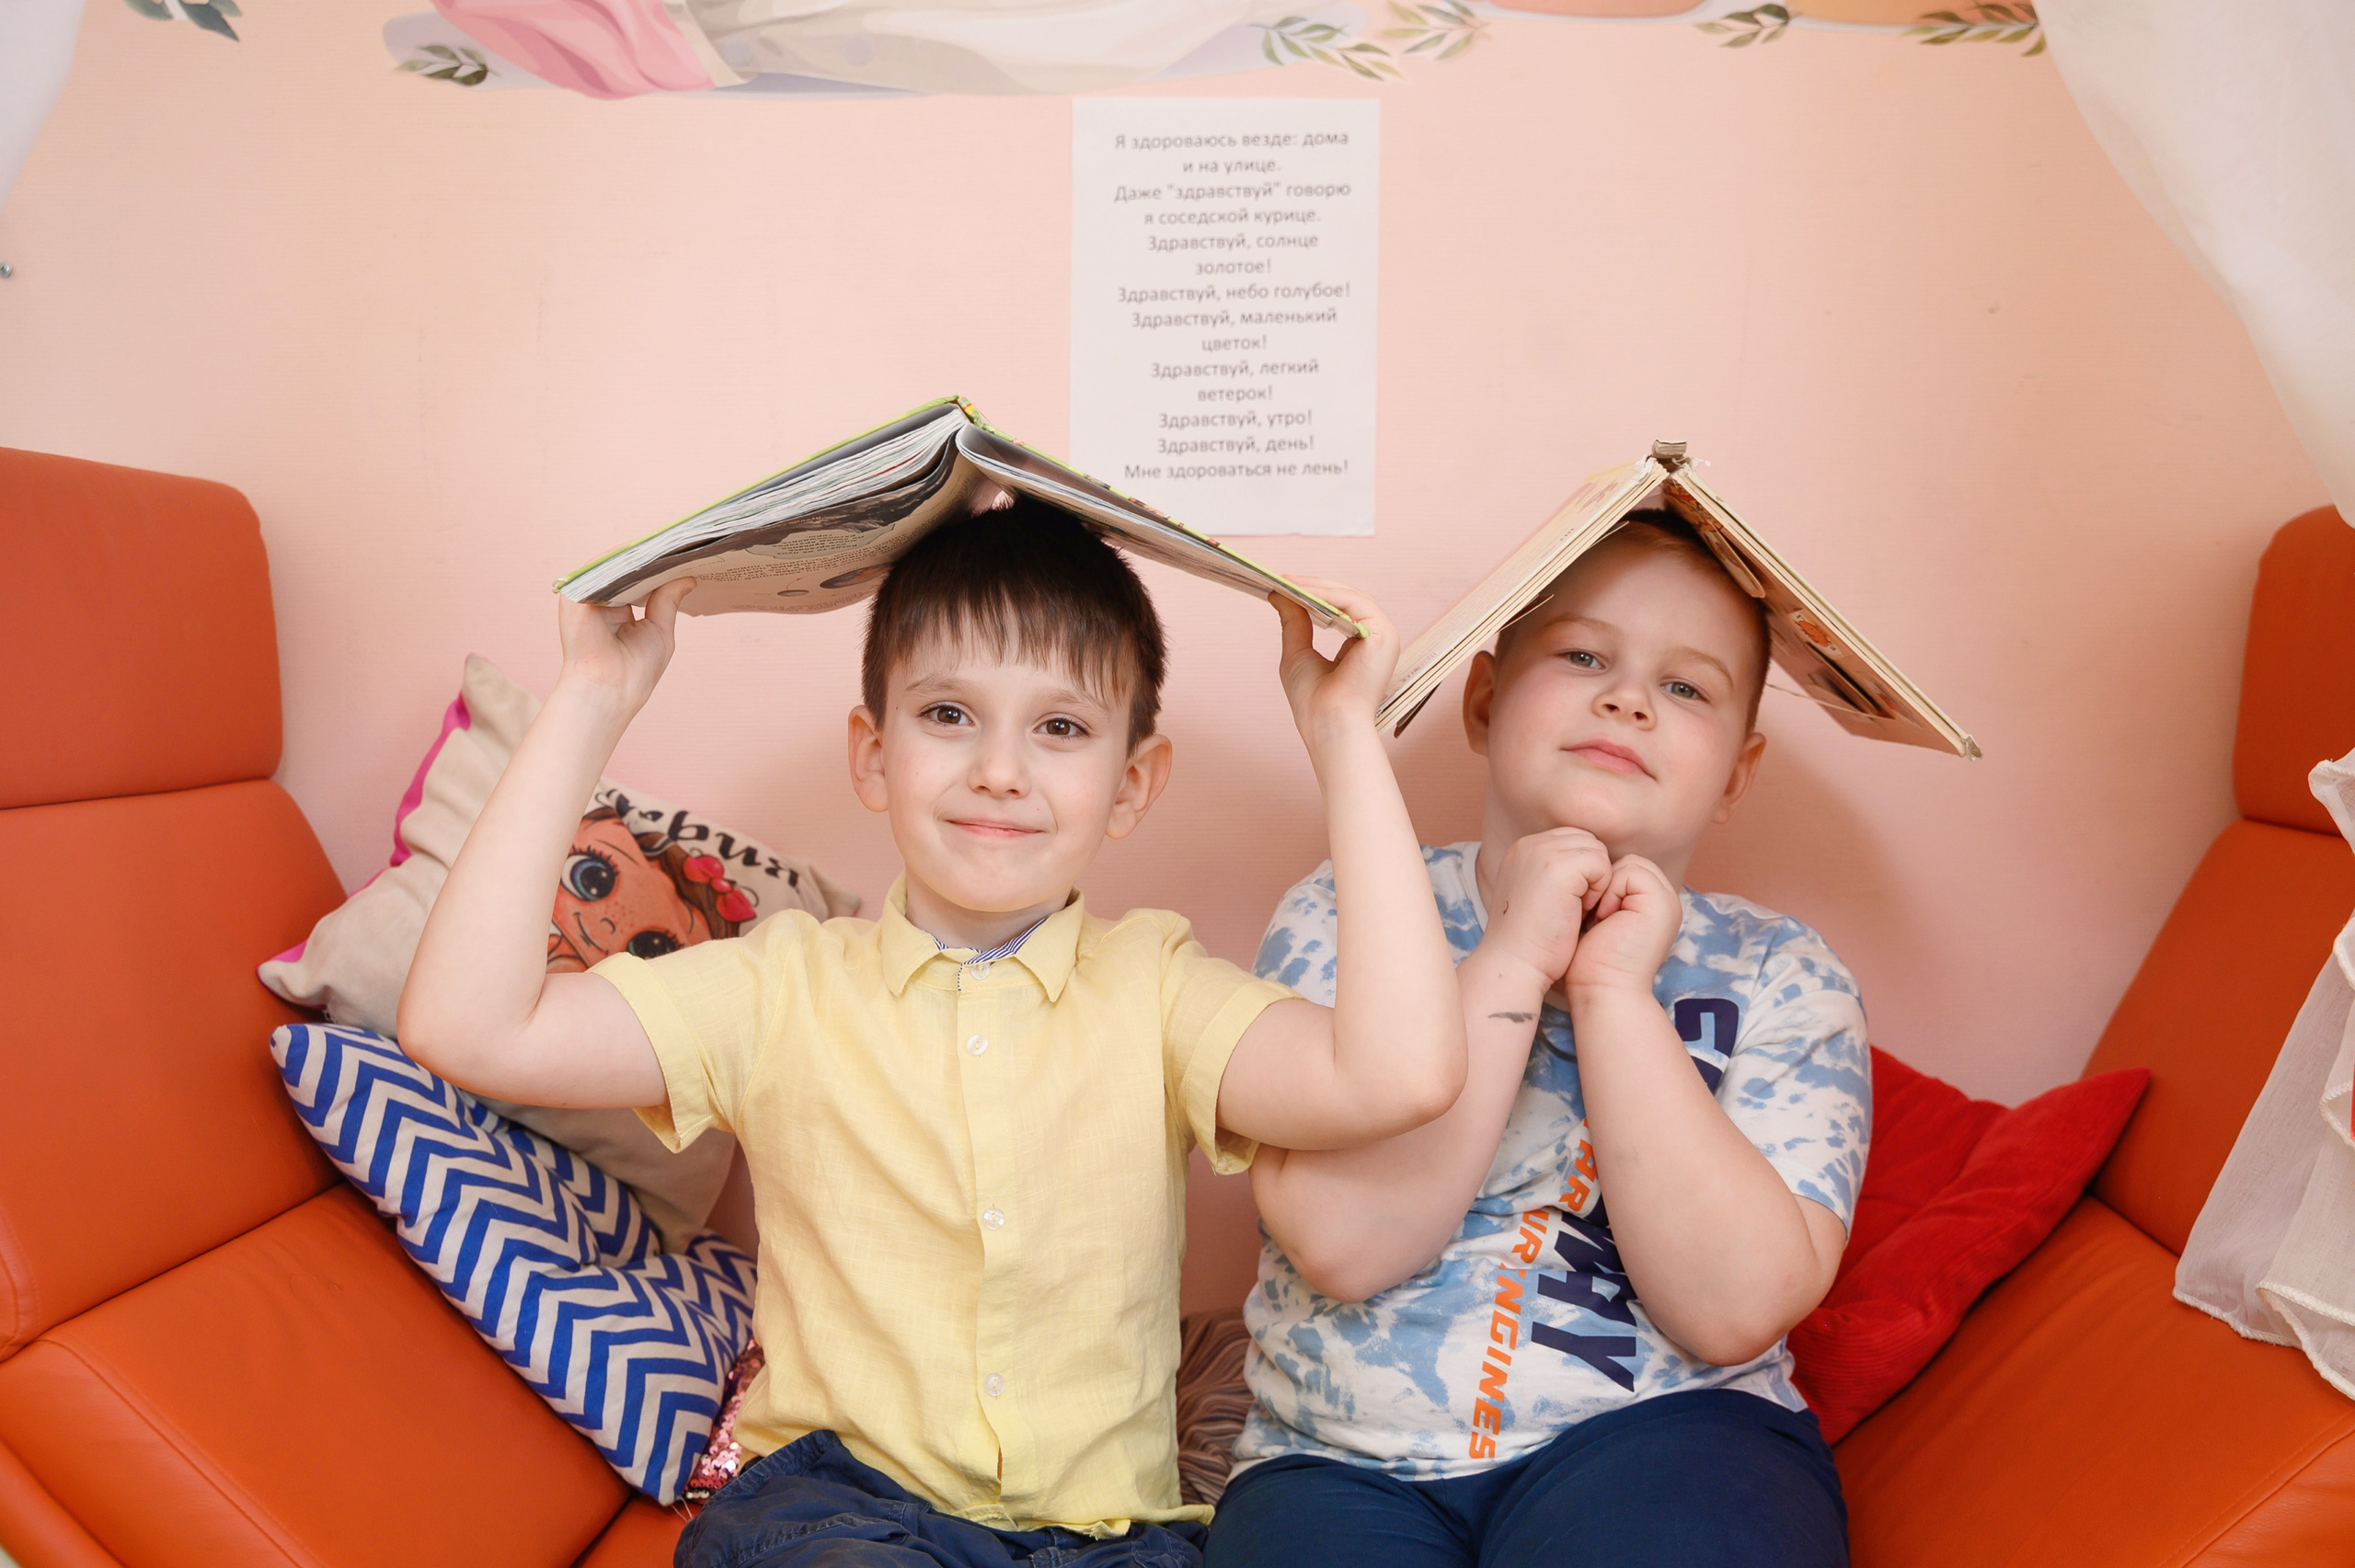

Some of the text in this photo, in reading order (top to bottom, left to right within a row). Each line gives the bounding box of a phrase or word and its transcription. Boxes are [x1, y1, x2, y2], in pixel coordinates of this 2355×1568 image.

[1115, 132, 1349, 151] Я здороваюсь везде: дома
[1183, 160, 1281, 176] и на улице.
[1114, 181, 1351, 203] Даже "здравствуй" говорю
[1144, 208, 1321, 226] я соседской курице.
[1148, 233, 1319, 253] Здравствуй, солнце
[1196, 258, 1271, 275] золотое!
[1118, 281, 1350, 304] Здравствуй, небо голубое!
[1132, 307, 1338, 330] Здравствуй, маленький
[1202, 335, 1267, 353] цветок!
[1152, 359, 1319, 380] Здравствуй, легкий
[1198, 384, 1272, 404] ветерок!
[1159, 409, 1312, 430] Здравствуй, утро!
[1158, 435, 1314, 456] Здравствуй, день!
[1125, 459, 1348, 480] Мне здороваться не лень!
